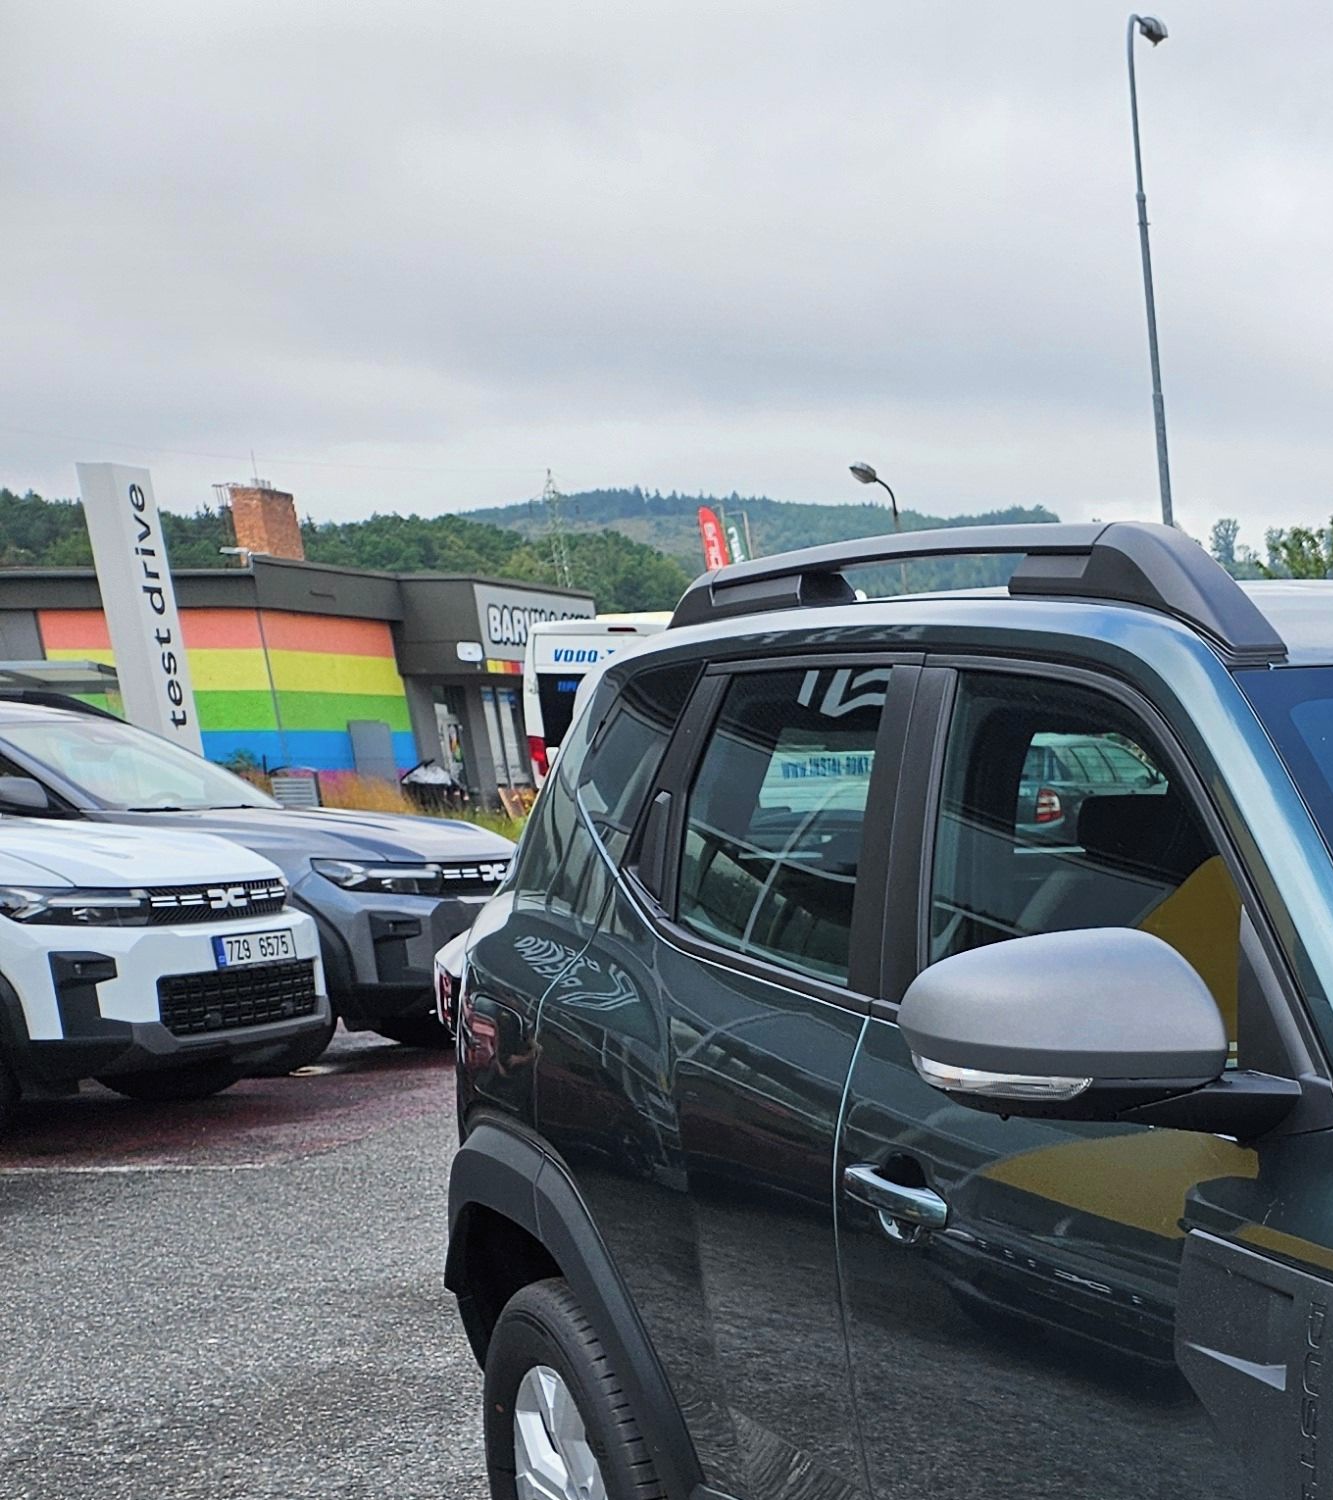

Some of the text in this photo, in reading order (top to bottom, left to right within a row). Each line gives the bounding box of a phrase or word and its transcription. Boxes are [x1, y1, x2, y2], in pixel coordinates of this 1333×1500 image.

[128, 483, 187, 730] test drive
[226, 934, 289, 962] 7Z9 6575
